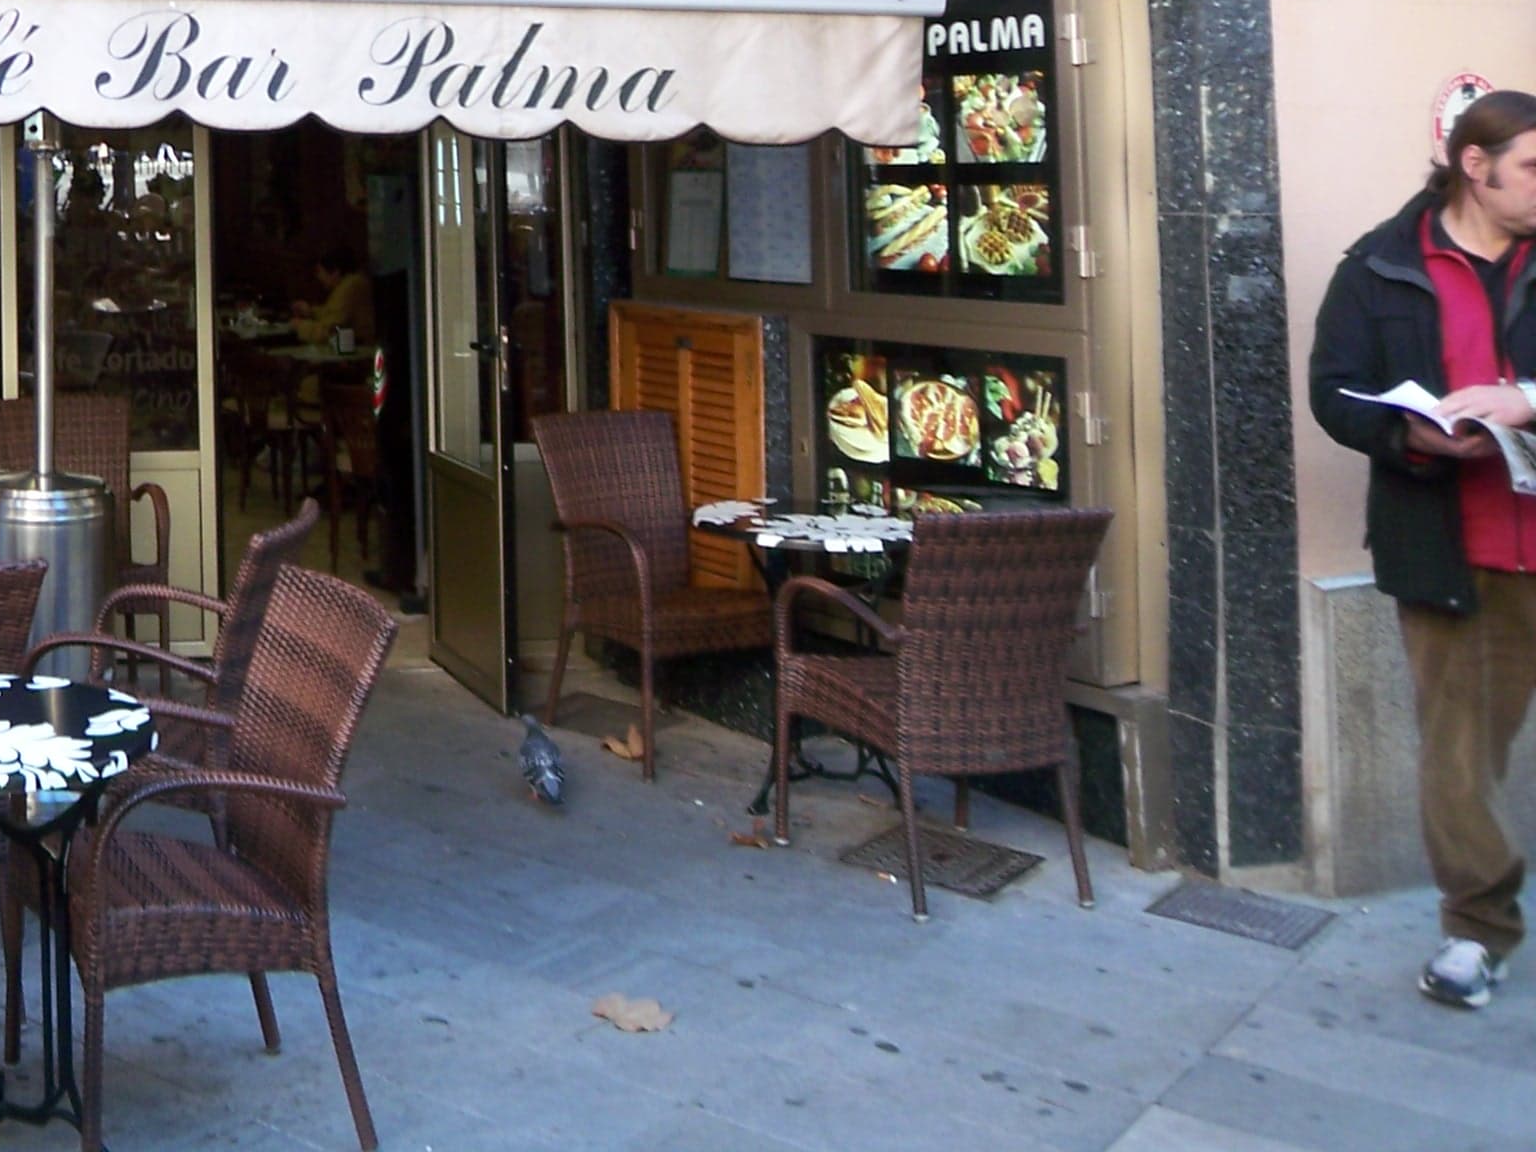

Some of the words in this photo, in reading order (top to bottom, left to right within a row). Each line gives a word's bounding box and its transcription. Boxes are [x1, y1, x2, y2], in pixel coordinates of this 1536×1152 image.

[94, 8, 298, 102] Bar
[358, 16, 681, 113] Palma
[927, 13, 1045, 56] PALMA
